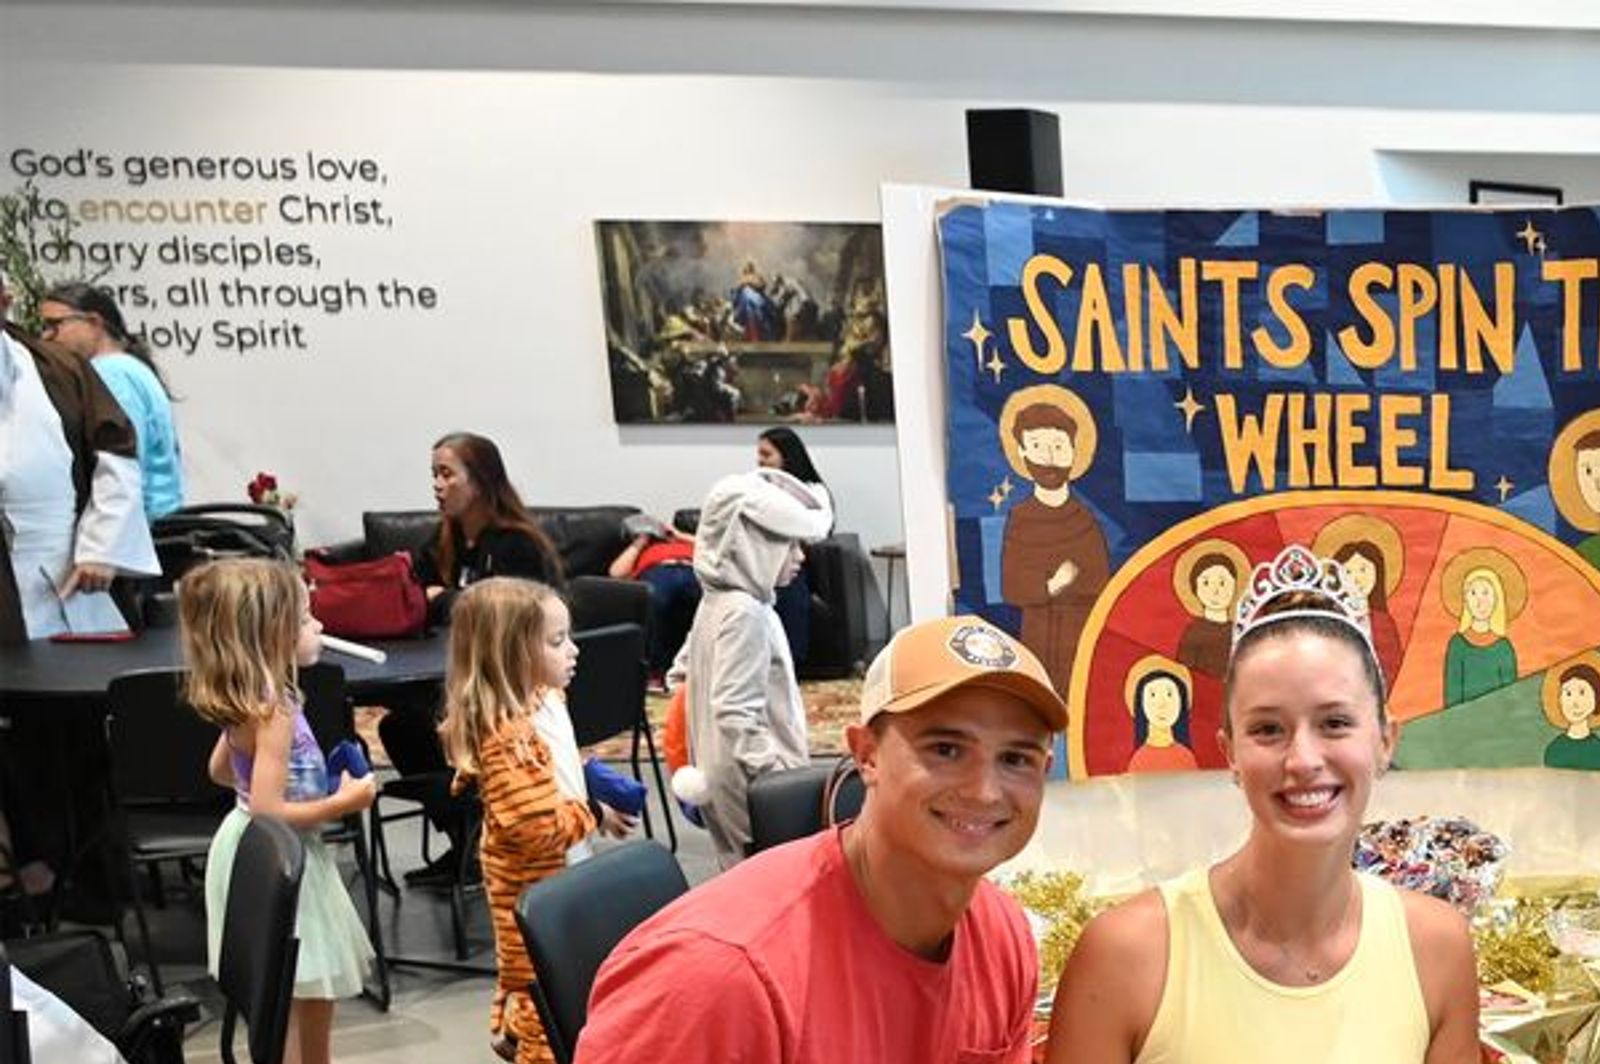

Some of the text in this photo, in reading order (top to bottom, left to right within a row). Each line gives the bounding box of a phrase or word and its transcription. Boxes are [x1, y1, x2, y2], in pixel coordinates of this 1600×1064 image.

[10, 148, 388, 186] God's generous love,
[79, 197, 268, 225] encounter
[279, 194, 393, 227] Christ,
[31, 235, 321, 271] ionary disciples,
[166, 277, 209, 307] all
[219, 280, 367, 313] through
[378, 279, 438, 308] the
[1007, 253, 1317, 376] SAINTS
[1338, 261, 1516, 376] SPIN
[213, 319, 308, 352] Spirit
[1215, 393, 1477, 494] WHEEL
